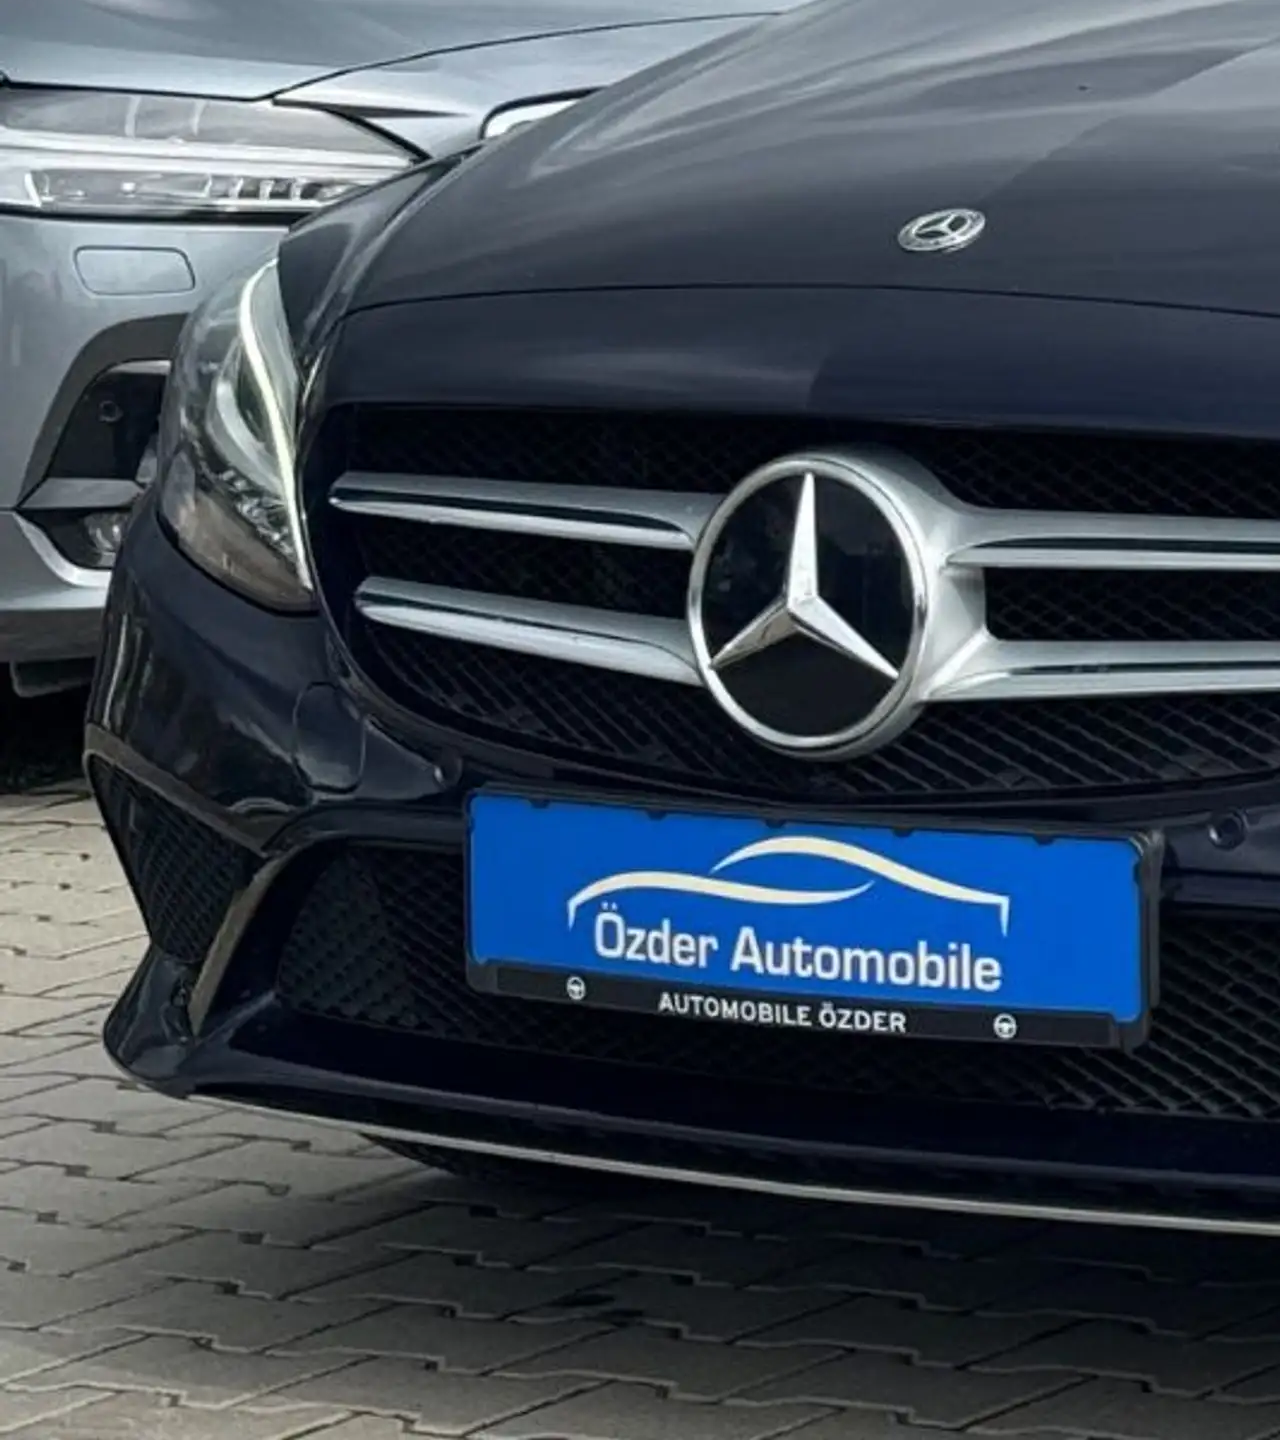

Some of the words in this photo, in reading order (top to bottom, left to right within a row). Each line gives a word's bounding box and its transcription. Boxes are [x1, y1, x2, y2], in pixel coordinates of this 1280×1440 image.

[595, 901, 719, 969] Özder
[729, 925, 1003, 992] Automobile
[658, 991, 812, 1027] AUTOMOBILE
[818, 1000, 907, 1034] ÖZDER
